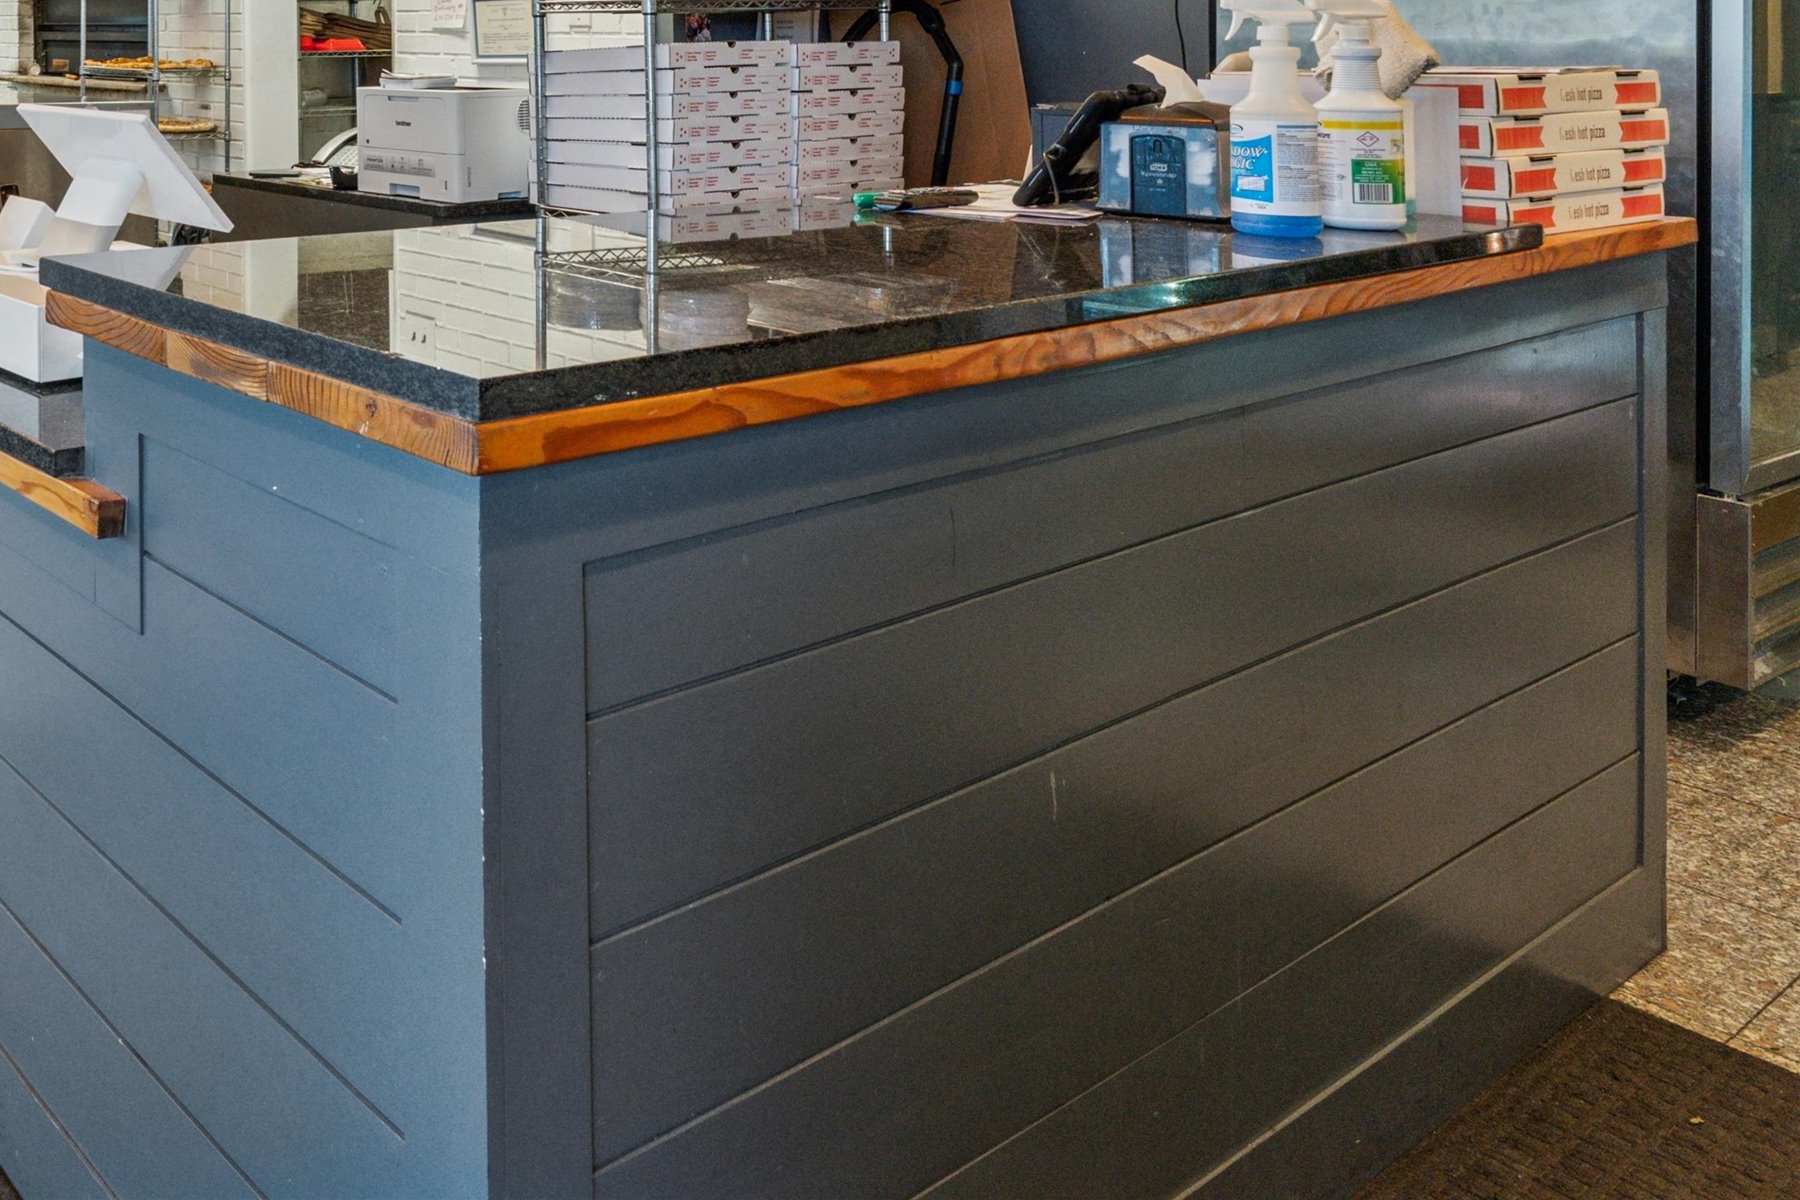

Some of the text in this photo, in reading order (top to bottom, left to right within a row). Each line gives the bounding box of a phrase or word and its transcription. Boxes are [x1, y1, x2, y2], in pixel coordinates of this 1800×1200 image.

[1588, 87, 1602, 103] pizza
[1590, 125, 1606, 141] pizza
[1597, 166, 1610, 183] pizza
[1596, 204, 1609, 219] pizza
